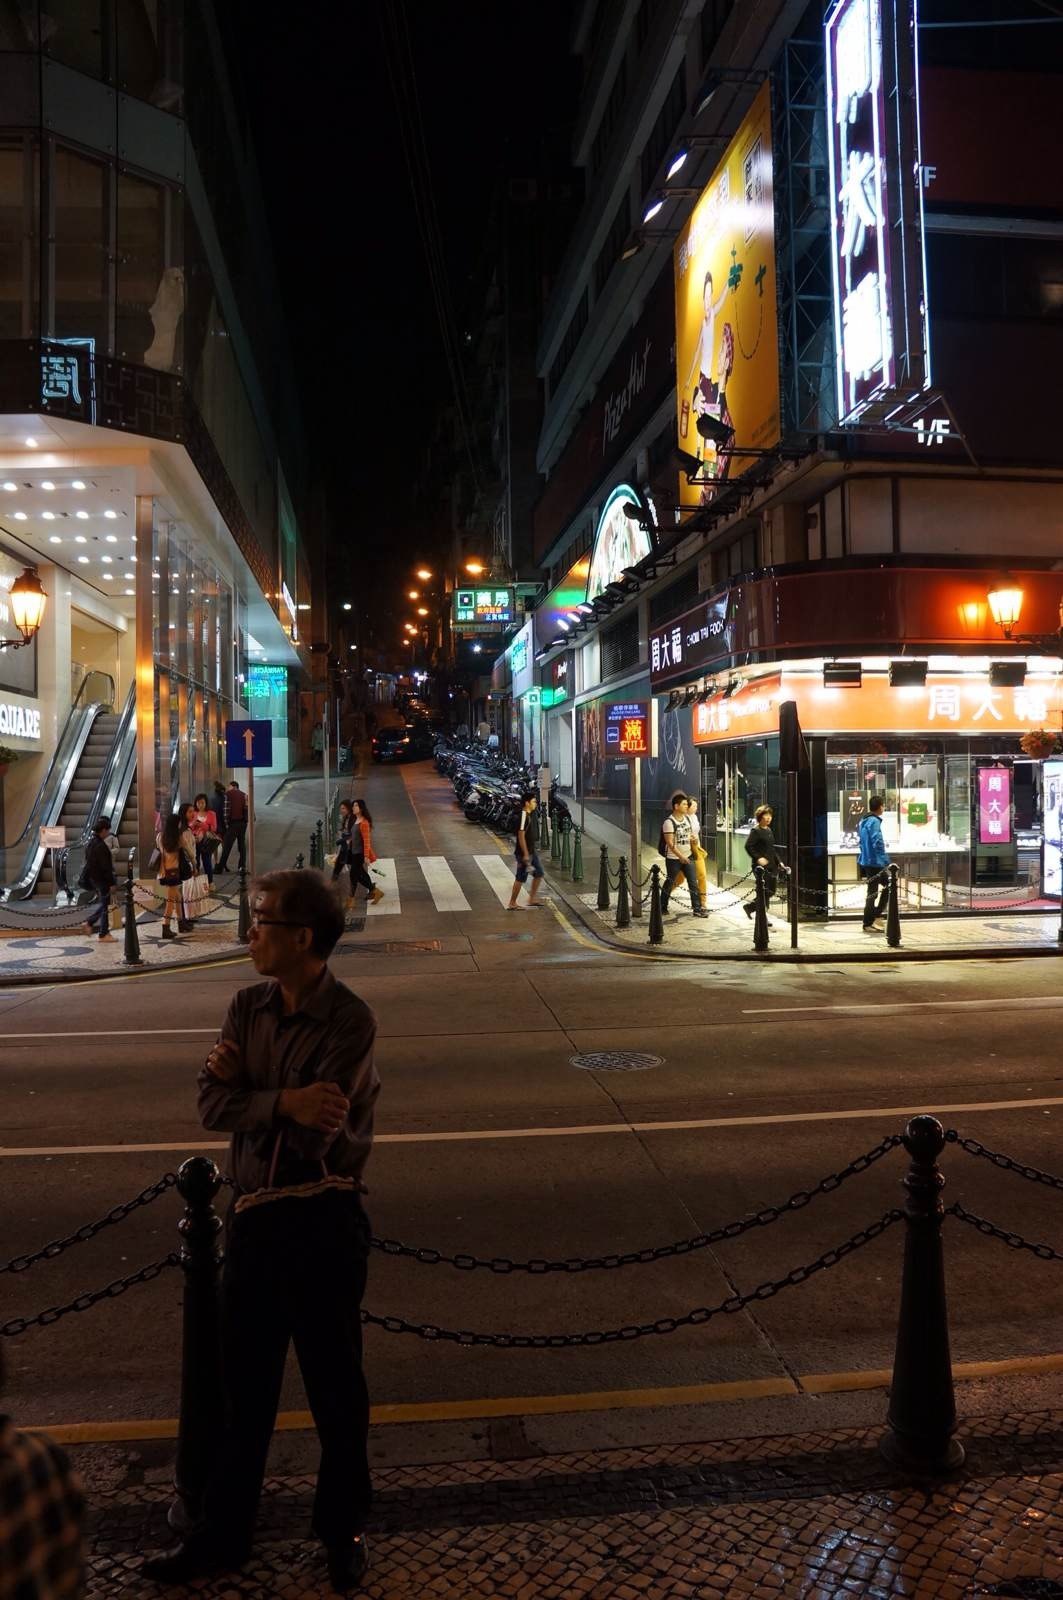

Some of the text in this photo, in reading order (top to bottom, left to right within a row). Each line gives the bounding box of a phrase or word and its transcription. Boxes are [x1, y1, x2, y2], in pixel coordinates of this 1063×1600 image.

[602, 337, 652, 457] Pizza Hut
[912, 418, 950, 446] 1/F
[651, 619, 724, 672] 周大福 CHOW TAI FOOK
[927, 685, 1048, 721] 周大福
[620, 740, 647, 751] FULL
[987, 776, 1003, 835] 周大福
